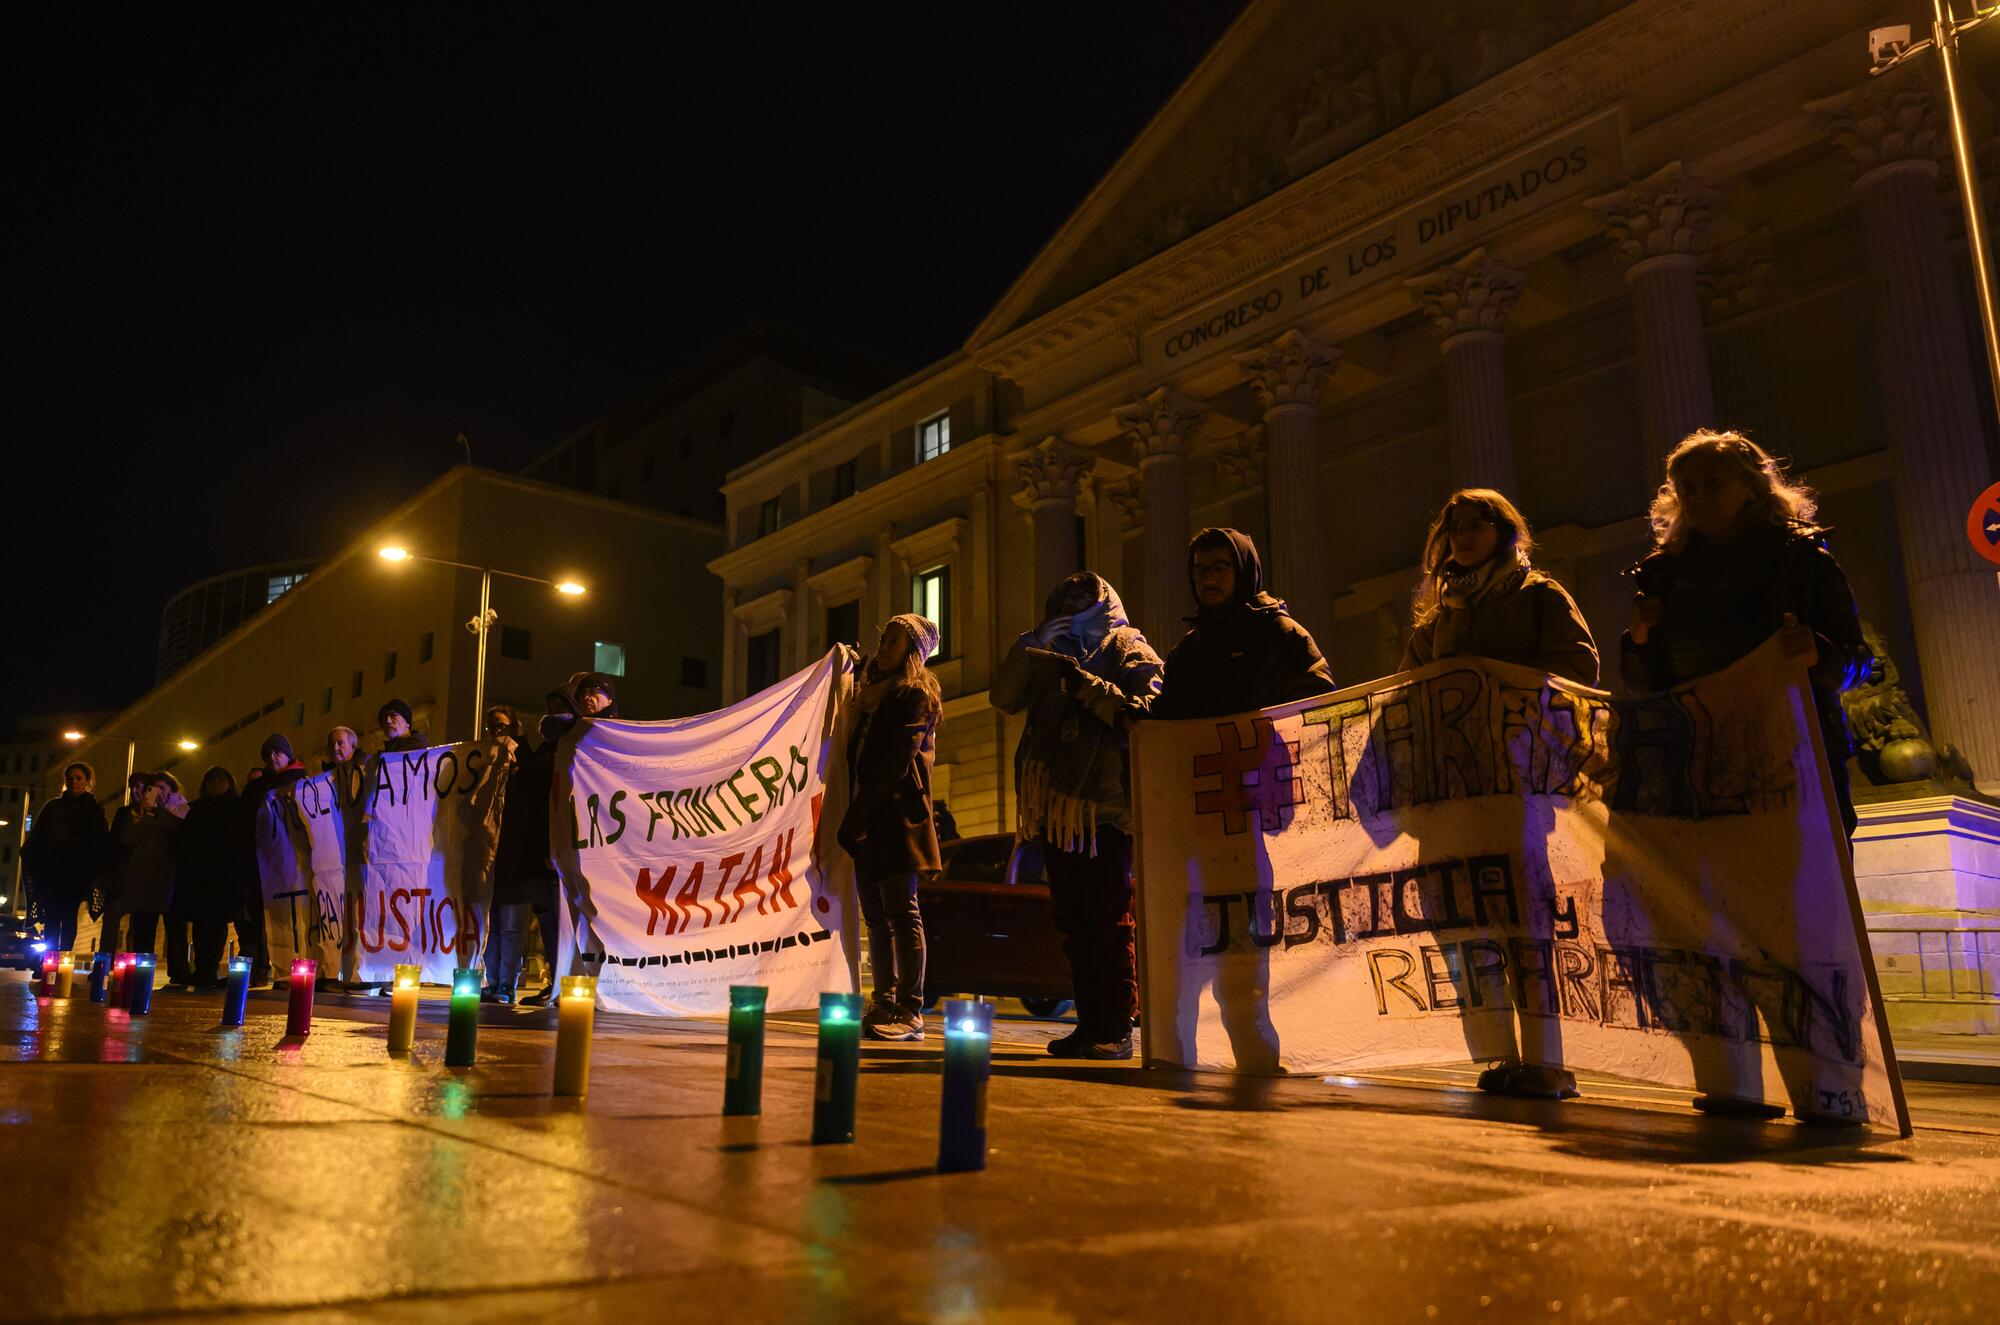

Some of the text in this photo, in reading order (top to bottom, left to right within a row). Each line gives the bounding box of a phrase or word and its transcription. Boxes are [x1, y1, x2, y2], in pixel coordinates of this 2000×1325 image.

[1163, 145, 1589, 359] CONGRESO DE LOS DIPUTADOS
[570, 744, 809, 850] LAS FRONTERAS
[1200, 852, 1521, 957] JUSTICIA
